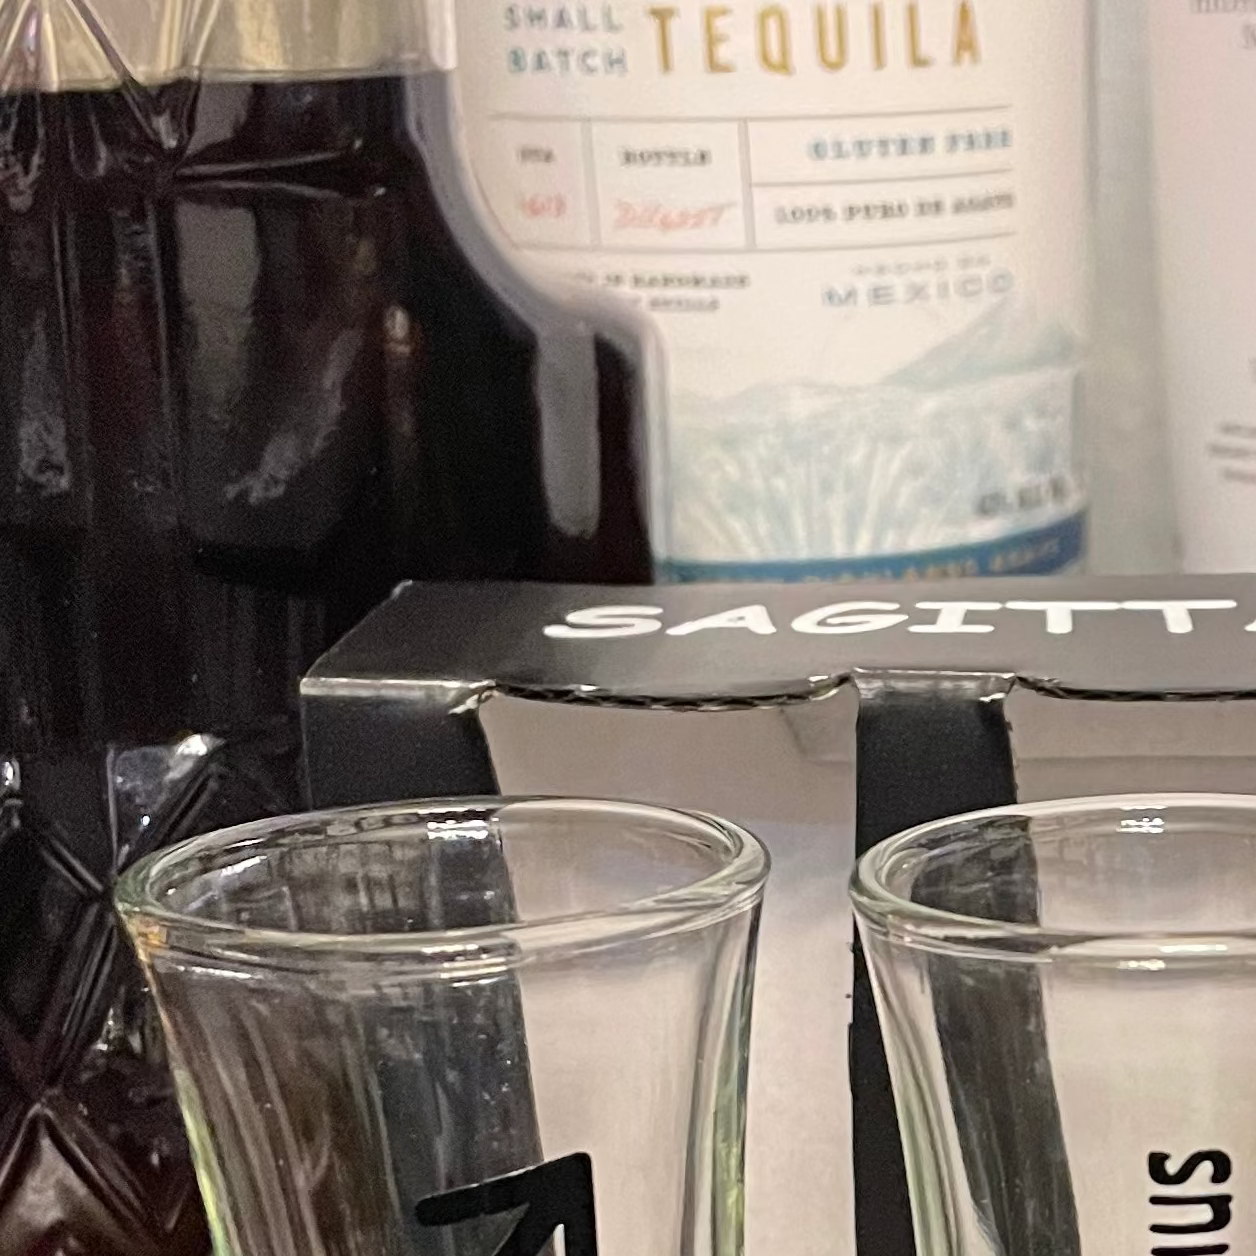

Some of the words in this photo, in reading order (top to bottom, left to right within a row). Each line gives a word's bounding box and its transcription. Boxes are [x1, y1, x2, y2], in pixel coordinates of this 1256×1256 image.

[504, 3, 625, 32] SMALL
[648, 0, 983, 76] TEQUILA
[507, 47, 628, 75] BATCH
[821, 266, 1015, 307] MEXICO
